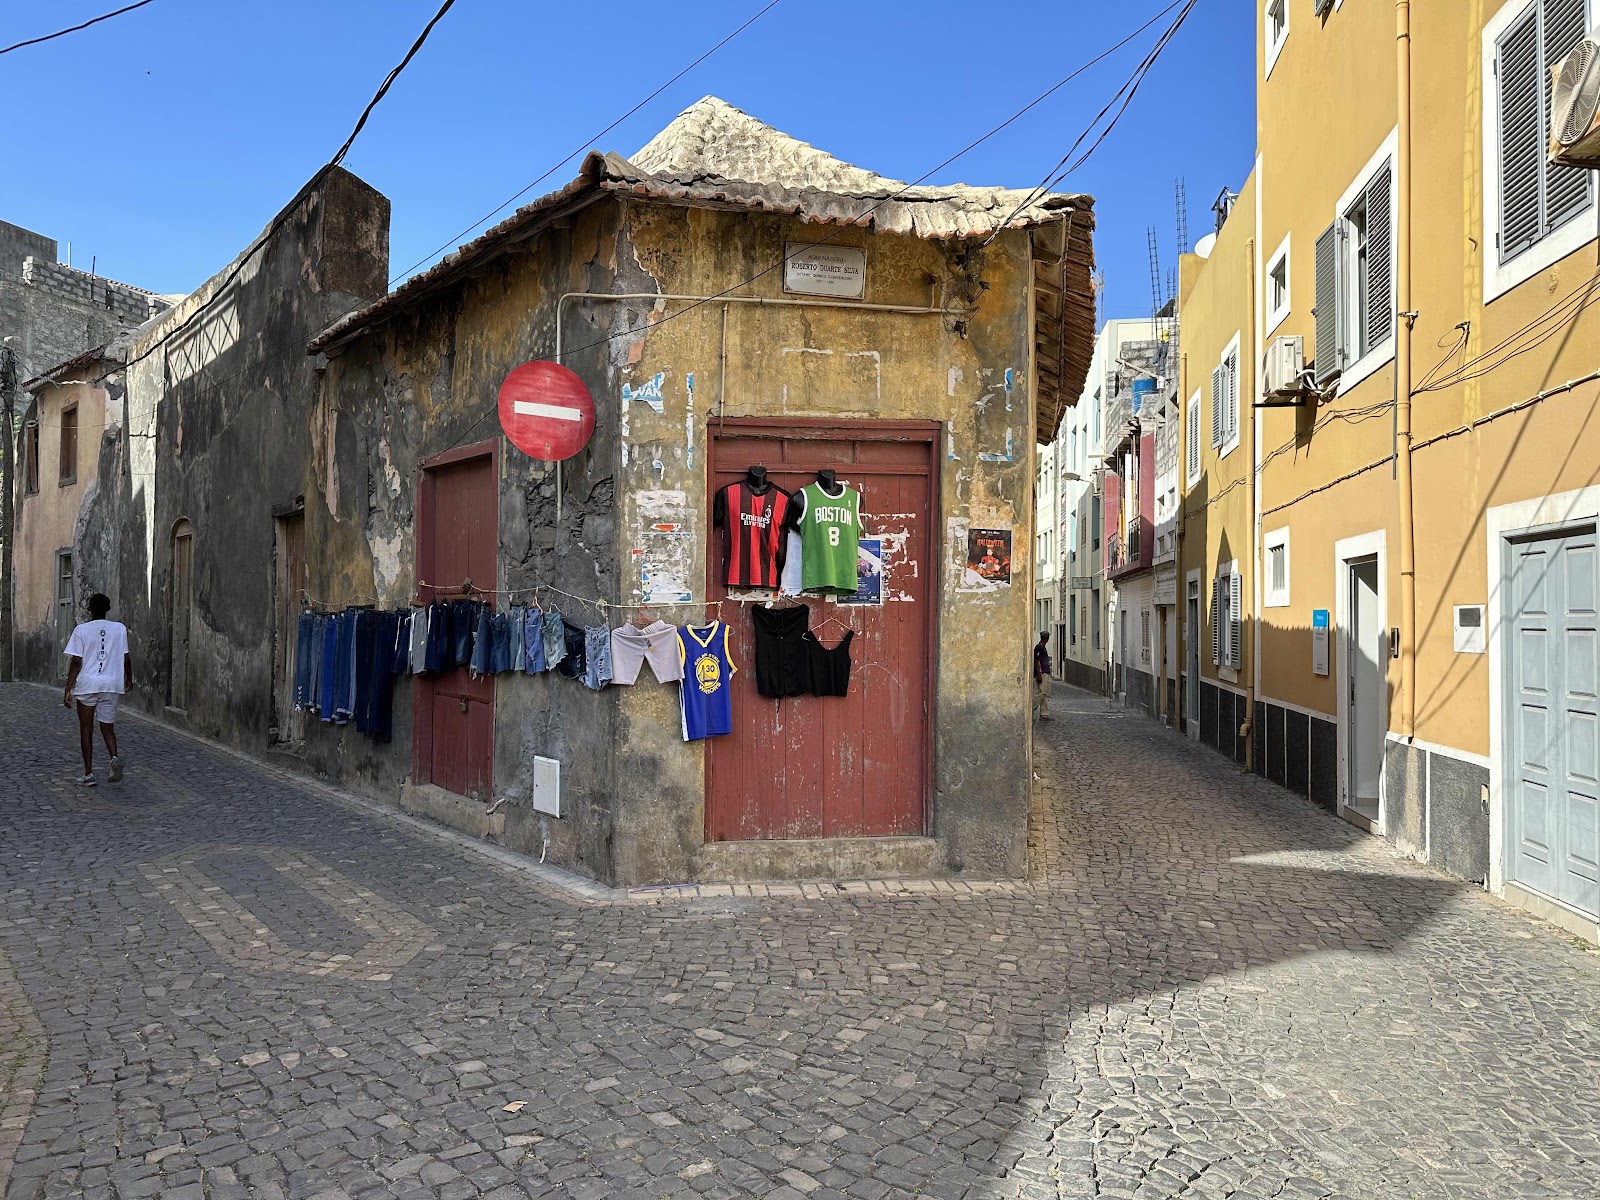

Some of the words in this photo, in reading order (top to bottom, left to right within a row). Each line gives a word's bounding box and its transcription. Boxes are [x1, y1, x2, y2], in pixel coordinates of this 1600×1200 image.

[791, 262, 818, 271] ROBERTO
[819, 264, 842, 273] DUARTE
[843, 266, 859, 275] SILVA
[740, 512, 771, 525] Emirates
[814, 506, 852, 527] BOSTON
[828, 526, 840, 547] 8
[705, 664, 716, 673] 30
